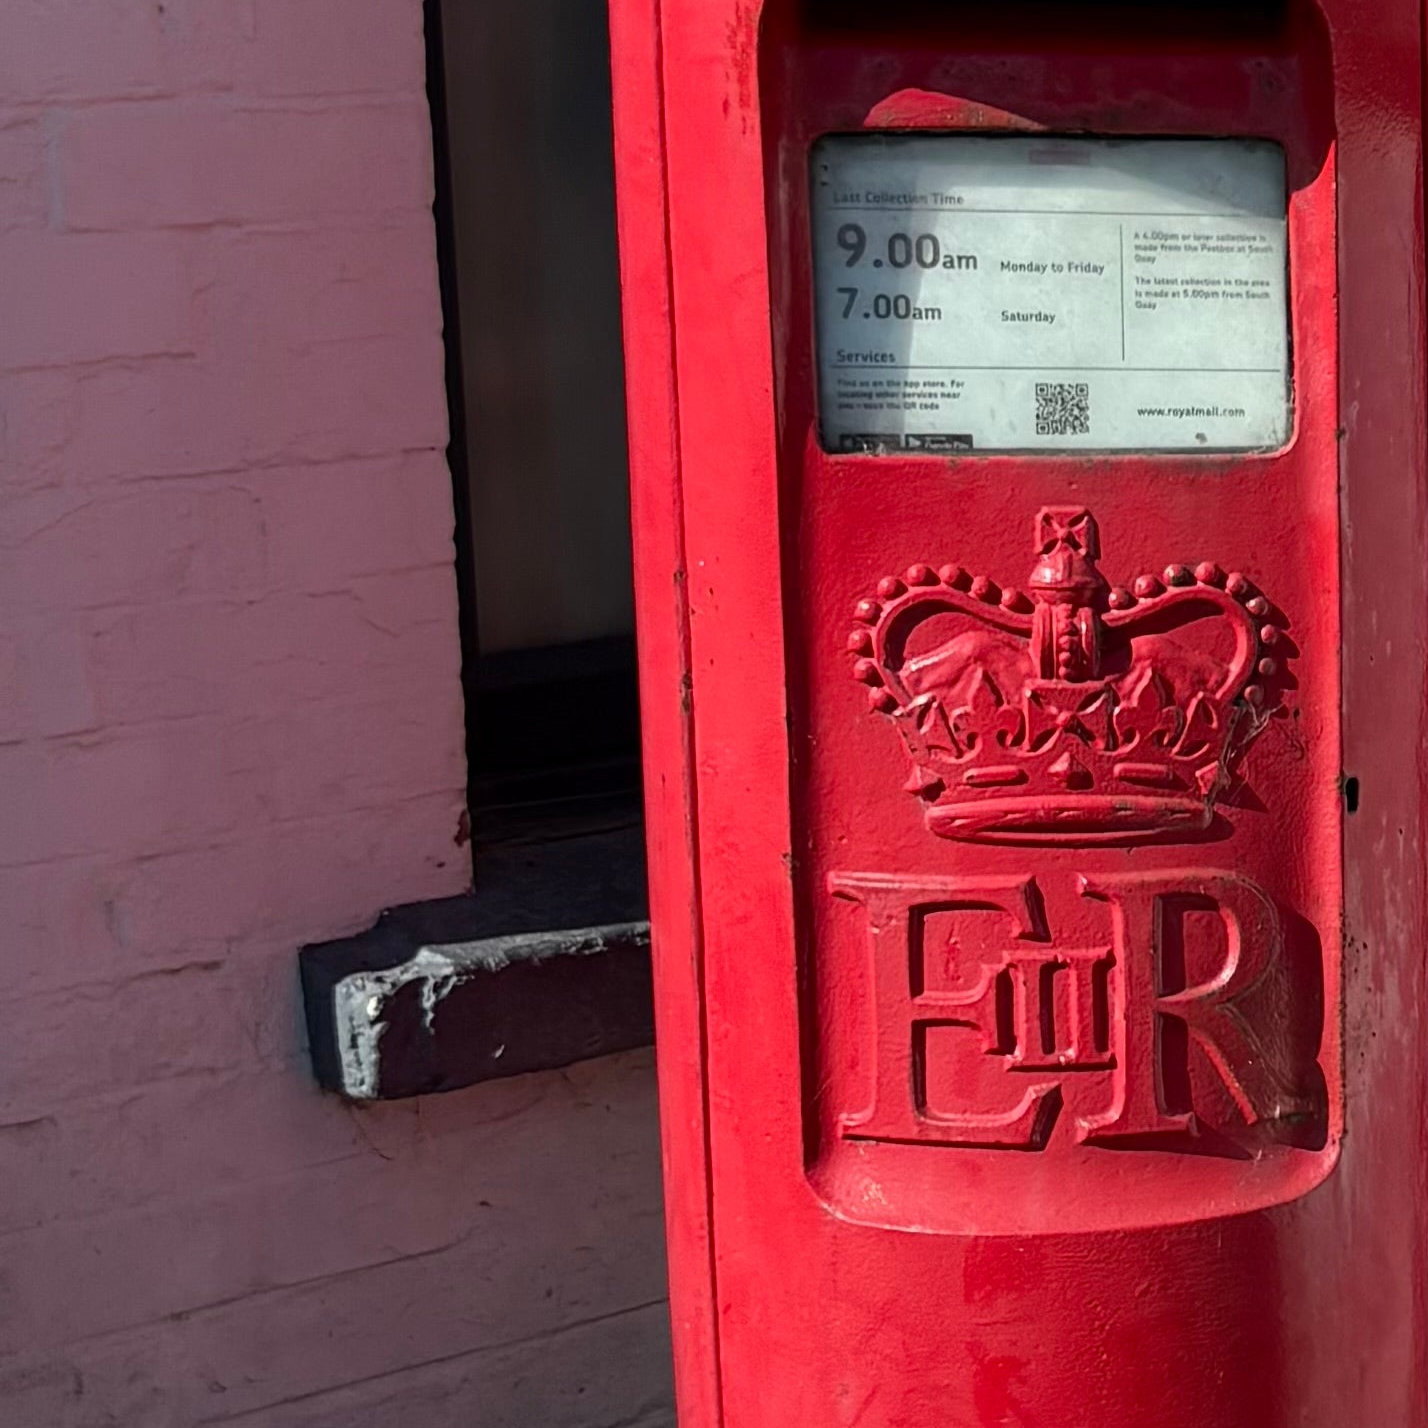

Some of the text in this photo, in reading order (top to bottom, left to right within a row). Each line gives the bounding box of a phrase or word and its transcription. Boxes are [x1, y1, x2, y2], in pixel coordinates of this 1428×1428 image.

[833, 191, 964, 204] Last Collection Time
[837, 223, 1104, 276] 9.00am Monday to Friday
[1135, 276, 1151, 285] The
[836, 287, 1055, 324] 7.00am Saturday
[837, 350, 895, 363] Services
[1137, 406, 1245, 418] www.royalmail.com
